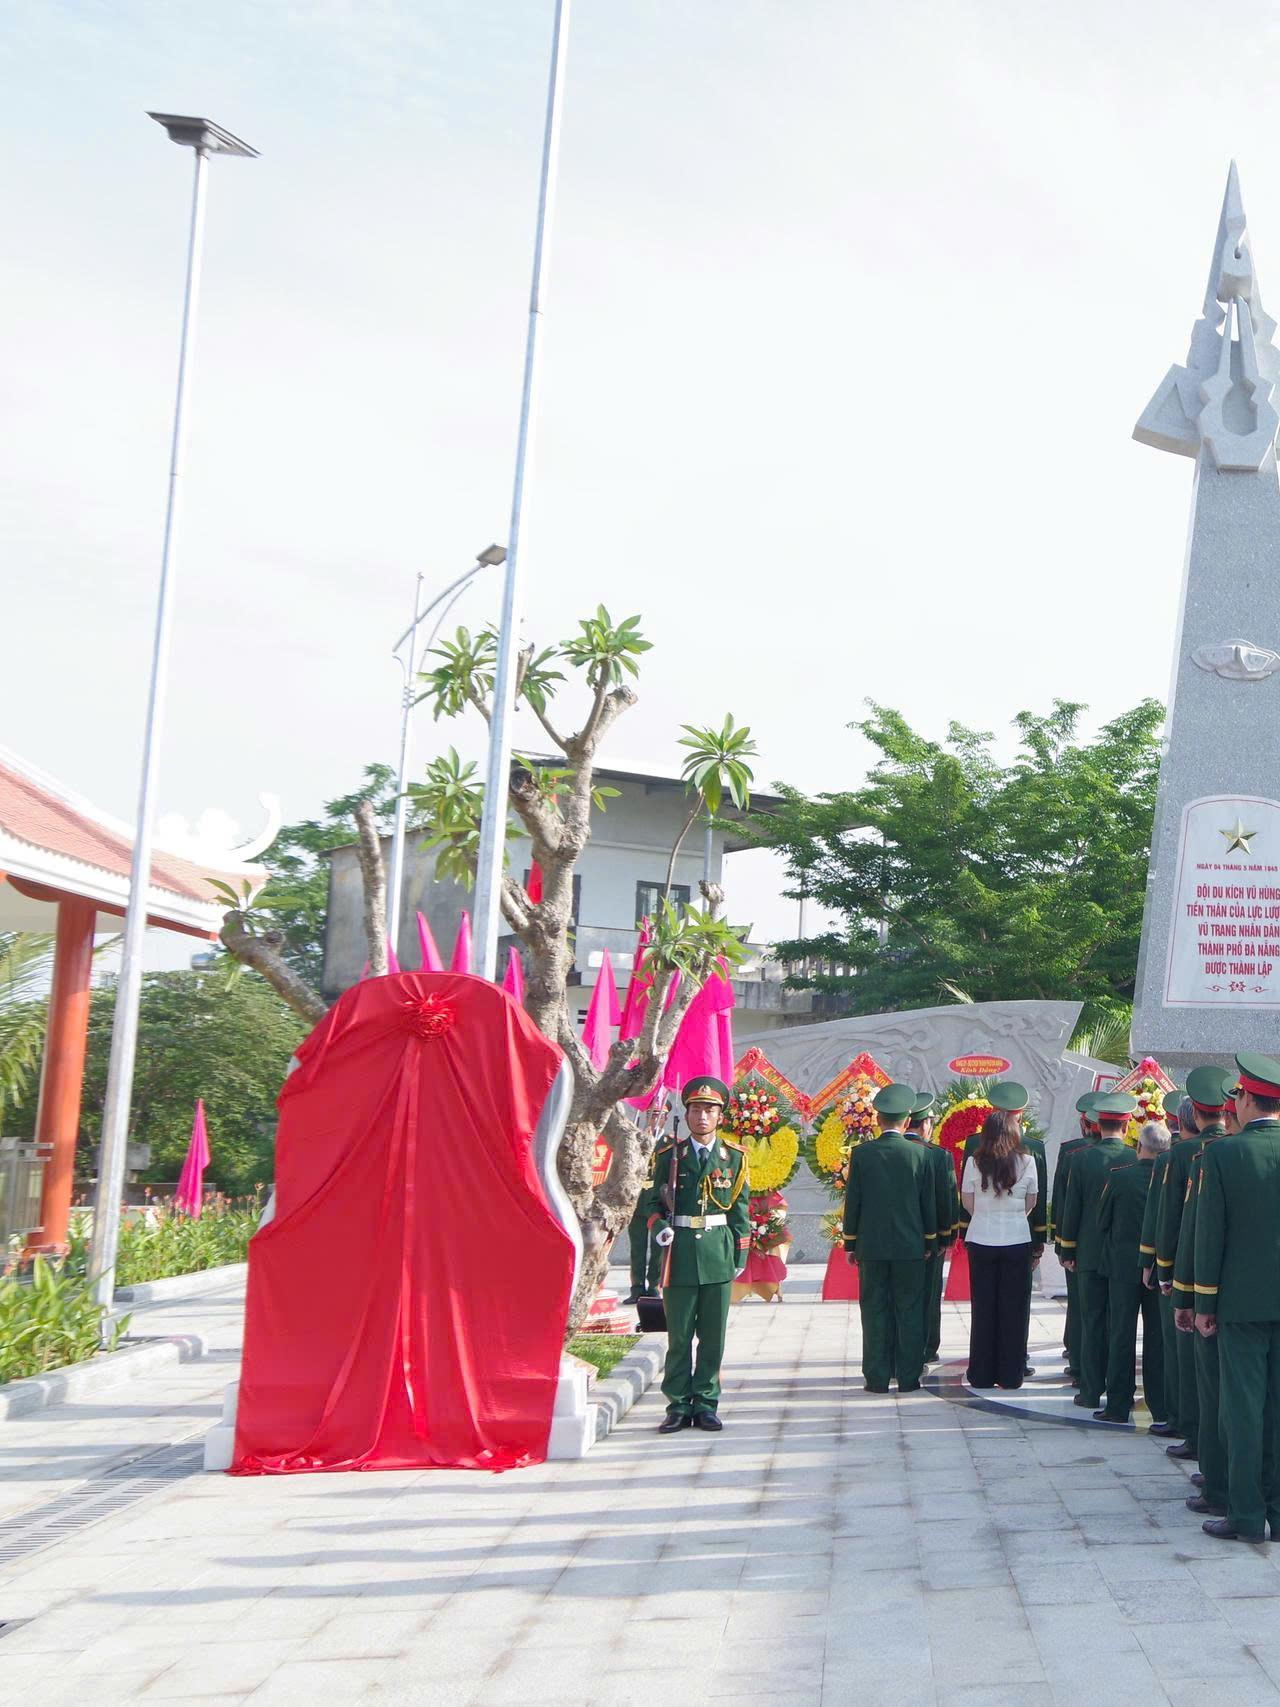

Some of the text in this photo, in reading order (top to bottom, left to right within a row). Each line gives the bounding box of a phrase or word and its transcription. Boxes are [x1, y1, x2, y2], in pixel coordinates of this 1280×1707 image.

[1197, 883, 1210, 901] ĐỘI
[1213, 886, 1223, 898] DU
[1225, 883, 1244, 899] KÍCH
[1246, 884, 1256, 899] VŨ
[1206, 902, 1227, 918] THÂN
[1229, 901, 1245, 918] CỦA
[1248, 906, 1263, 921] LỰC
[1198, 922, 1280, 938] VŨ TRANG NHÂN DÂN
[1198, 939, 1280, 957] THÀNH PHỐ ĐÀ NẴNG
[1205, 960, 1273, 978] ĐƯỢC THÀNH LẬP
